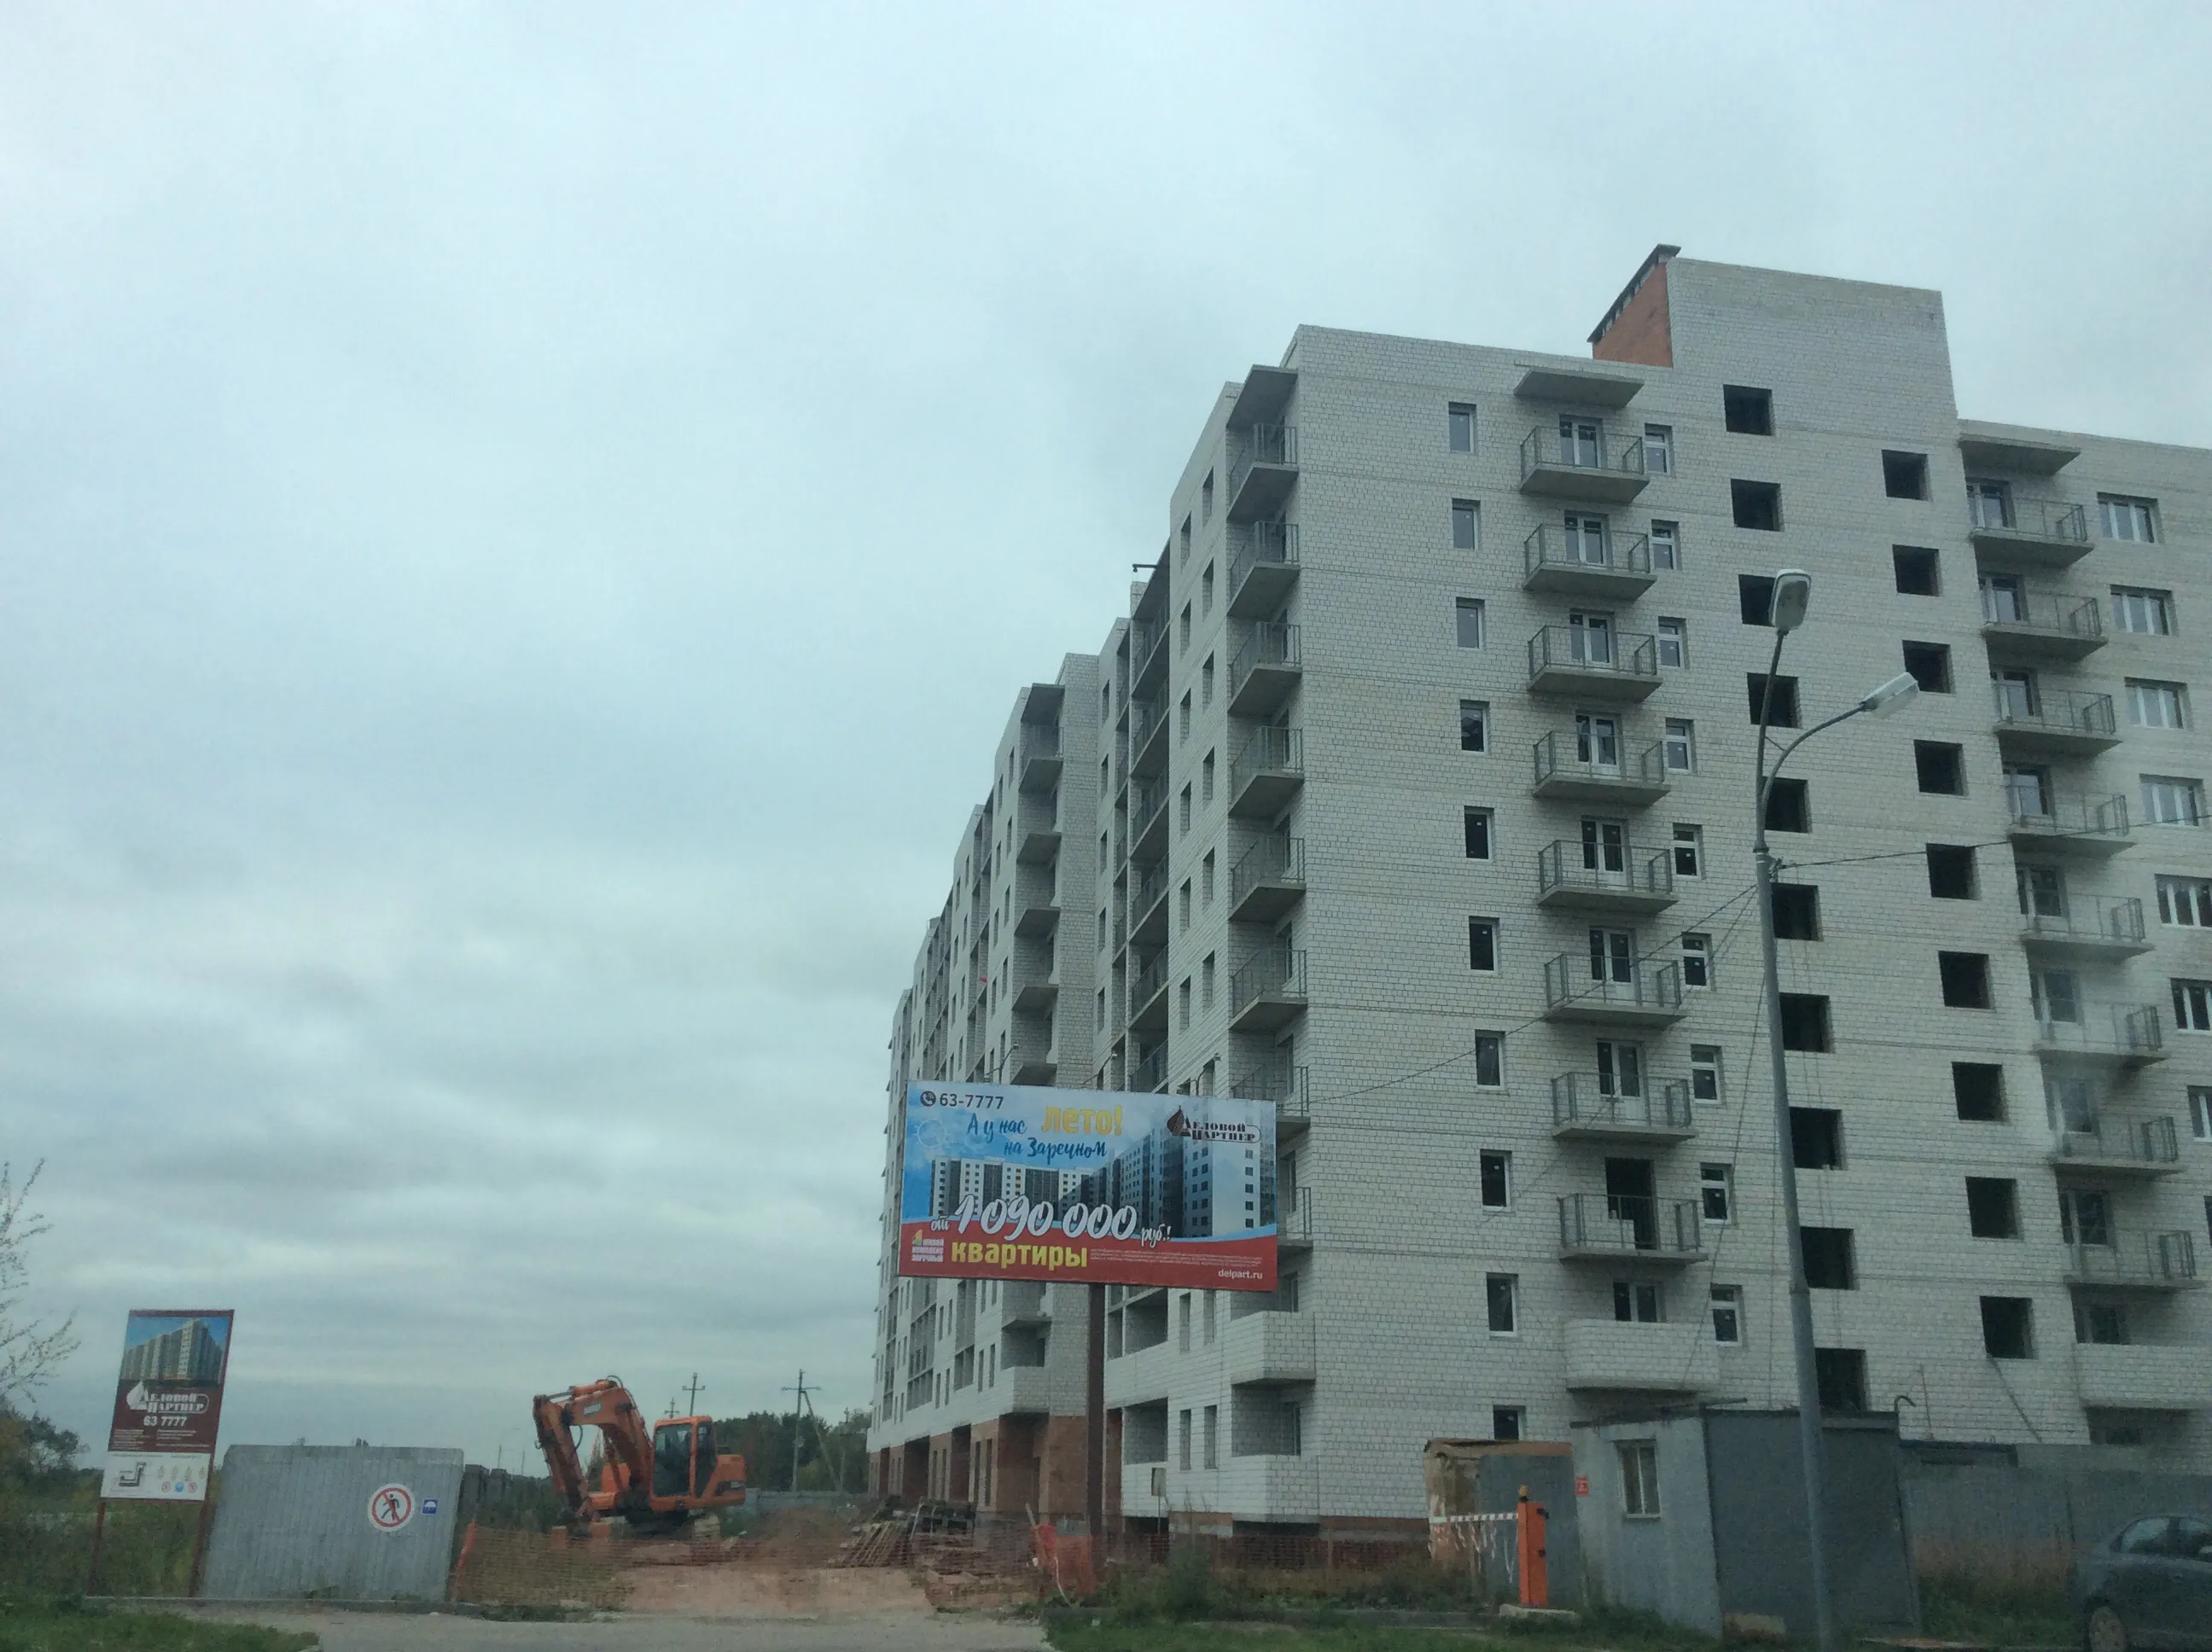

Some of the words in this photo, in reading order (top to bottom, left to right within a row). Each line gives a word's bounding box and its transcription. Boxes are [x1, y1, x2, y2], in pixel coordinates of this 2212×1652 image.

[940, 1093, 1004, 1109] 63-7777
[967, 1113, 979, 1136] А
[983, 1122, 994, 1143] у
[999, 1119, 1027, 1135] нас
[1041, 1104, 1123, 1137] лето!
[1004, 1140, 1024, 1156] на
[1027, 1137, 1108, 1166] Заречном
[1062, 1201, 1138, 1241] 000
[1140, 1223, 1173, 1248] руб.!
[951, 1241, 1088, 1271] квартиры
[1217, 1268, 1264, 1280] delpart.ru
[143, 1416, 158, 1427] 63
[160, 1416, 187, 1427] 7777
